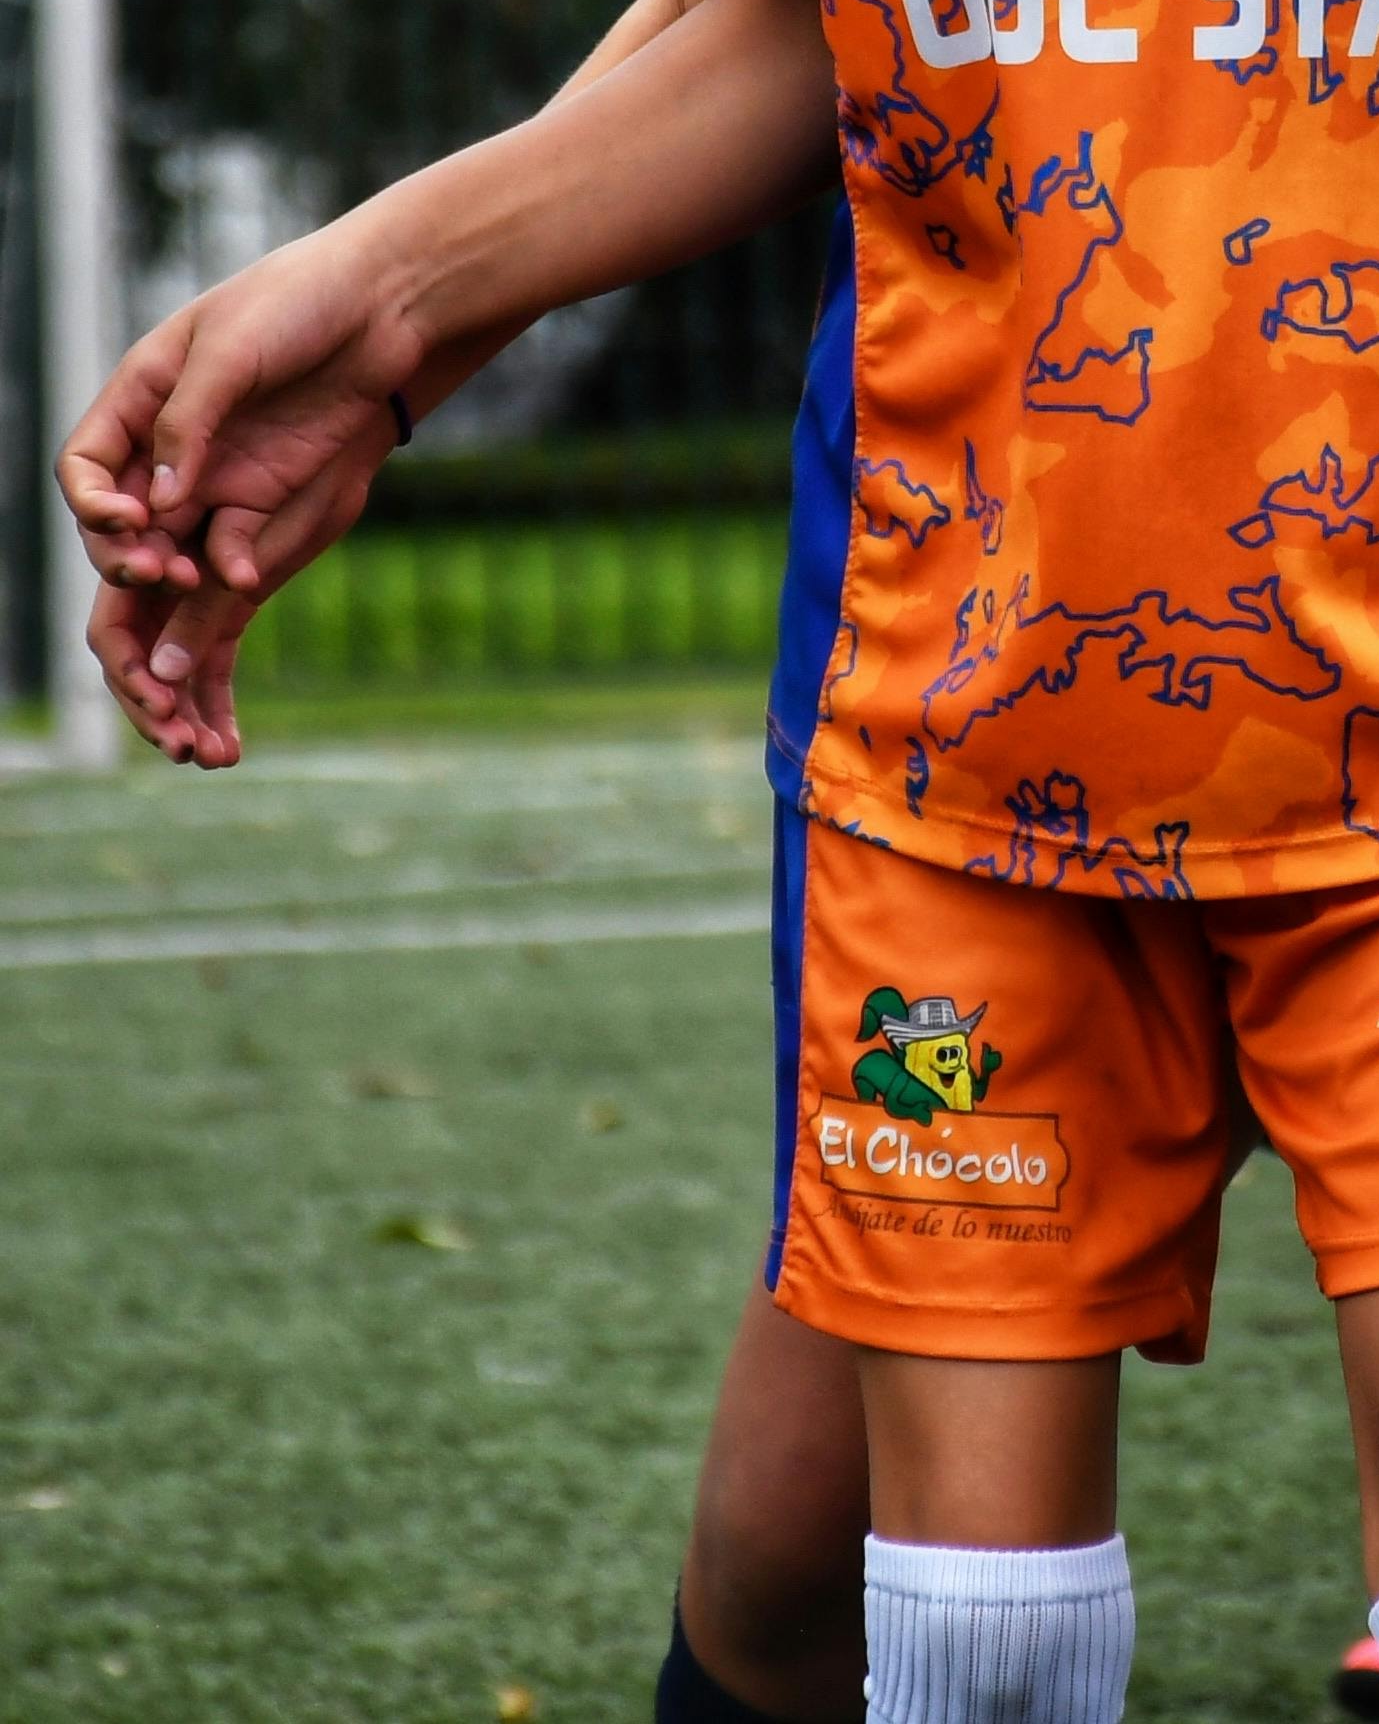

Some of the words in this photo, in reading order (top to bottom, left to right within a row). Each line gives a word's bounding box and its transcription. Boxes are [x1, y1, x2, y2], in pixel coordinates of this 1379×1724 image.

[818, 1116, 857, 1169] El
[913, 1207, 943, 1237] de
[952, 1209, 977, 1239] lo
[987, 1220, 1073, 1244] nuestro
